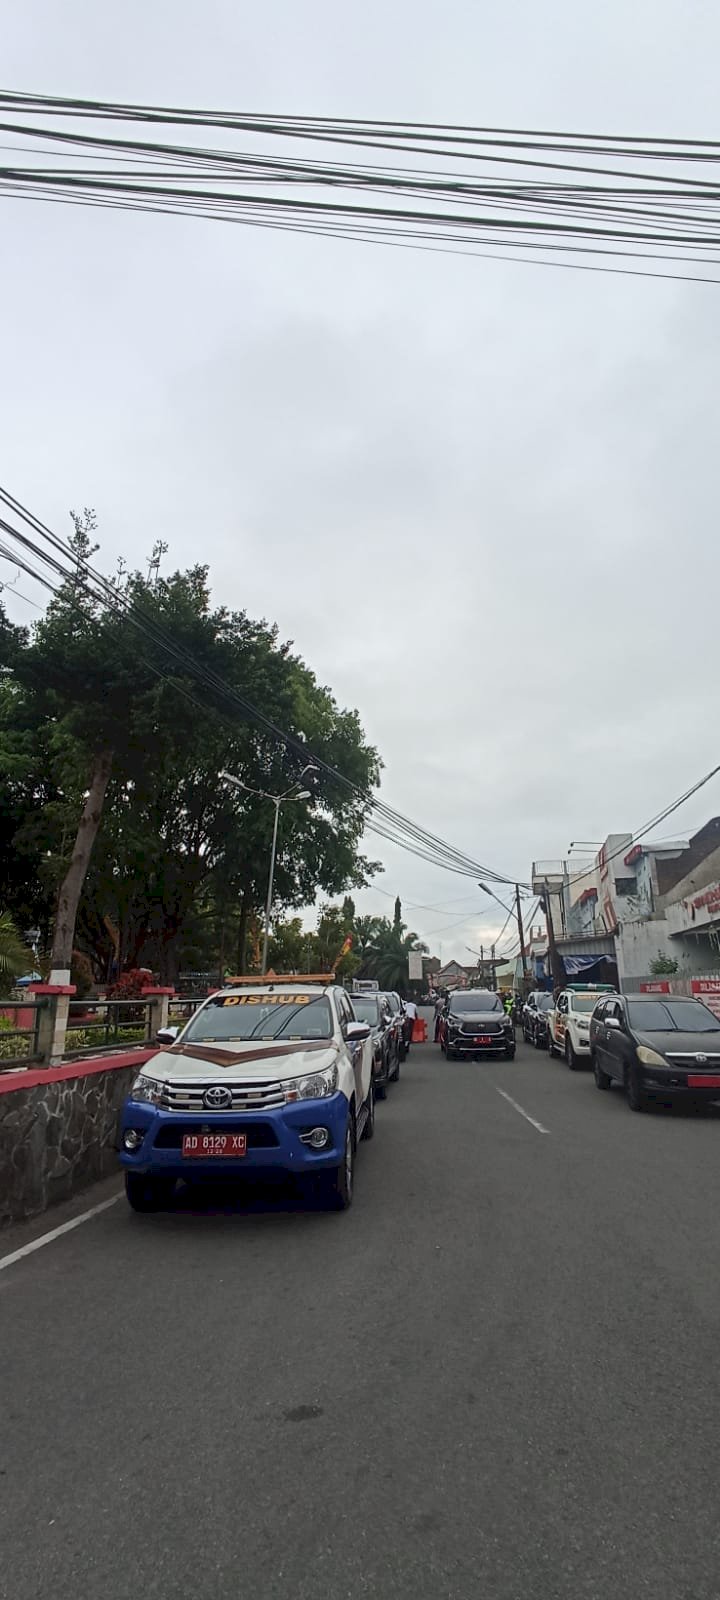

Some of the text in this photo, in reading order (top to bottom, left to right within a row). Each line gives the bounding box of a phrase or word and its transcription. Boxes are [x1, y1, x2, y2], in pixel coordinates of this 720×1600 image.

[223, 995, 310, 1006] DISHUB
[185, 1136, 244, 1149] AD 8129 XC
